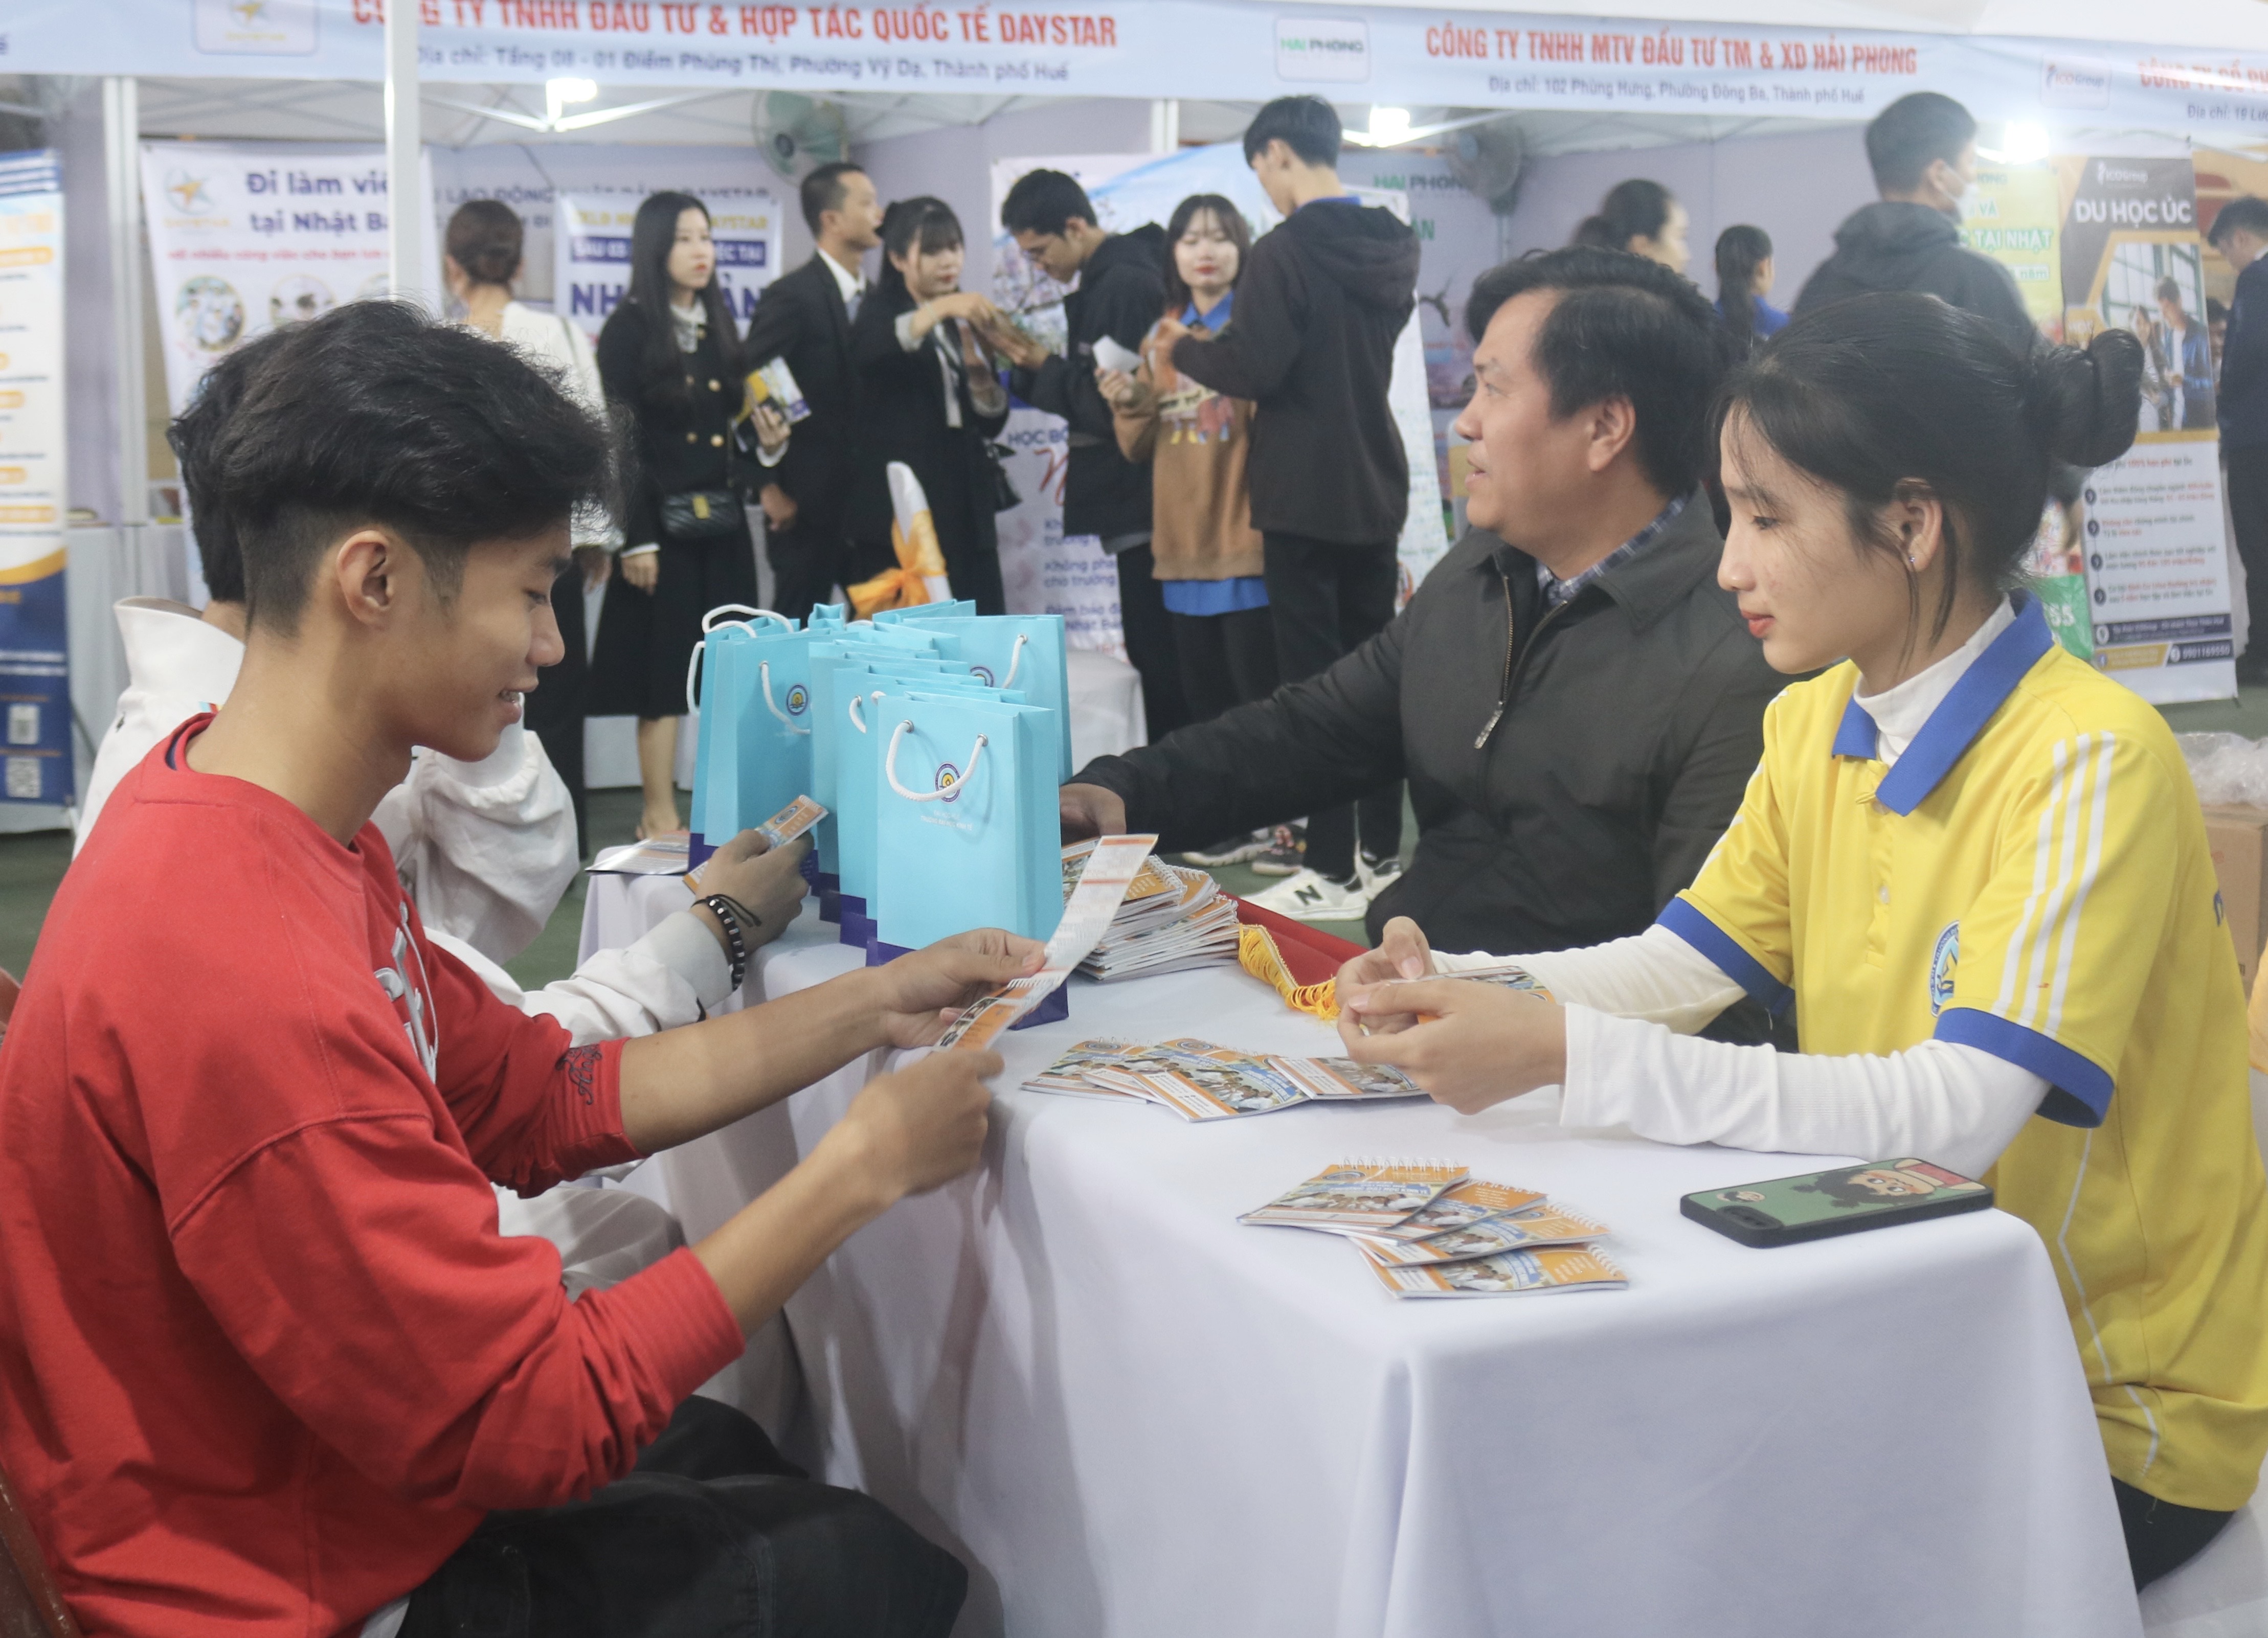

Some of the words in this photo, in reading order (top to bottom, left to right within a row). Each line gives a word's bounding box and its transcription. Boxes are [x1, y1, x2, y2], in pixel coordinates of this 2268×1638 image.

[452, 0, 484, 27] TY
[496, 0, 578, 30] TNHH
[708, 5, 728, 34] &
[739, 4, 797, 44] HỢP
[807, 1, 863, 38] TÁC
[872, 3, 949, 42] QUỐC
[957, 2, 991, 42] TẾ
[999, 11, 1117, 47] DAYSTAR
[1426, 21, 1488, 59] CÔNG
[1494, 29, 1520, 60] TY
[1527, 32, 1584, 62] TNHH
[1591, 33, 1635, 65] MTV
[1722, 39, 1753, 69] TM
[1759, 41, 1773, 69] &
[1780, 41, 1808, 71] XD
[1851, 46, 1918, 75] PHONG
[1544, 77, 1567, 96] 102
[246, 170, 277, 194] Đi
[287, 172, 342, 194] làm
[250, 210, 284, 238] tại
[294, 213, 356, 238] Nhật
[2075, 199, 2106, 223] DU
[2112, 201, 2157, 229] HỌC
[2163, 192, 2192, 223] ÚC
[1974, 228, 2002, 252] TẠI
[2005, 227, 2052, 253] NHẬT
[1294, 884, 1323, 906] N
